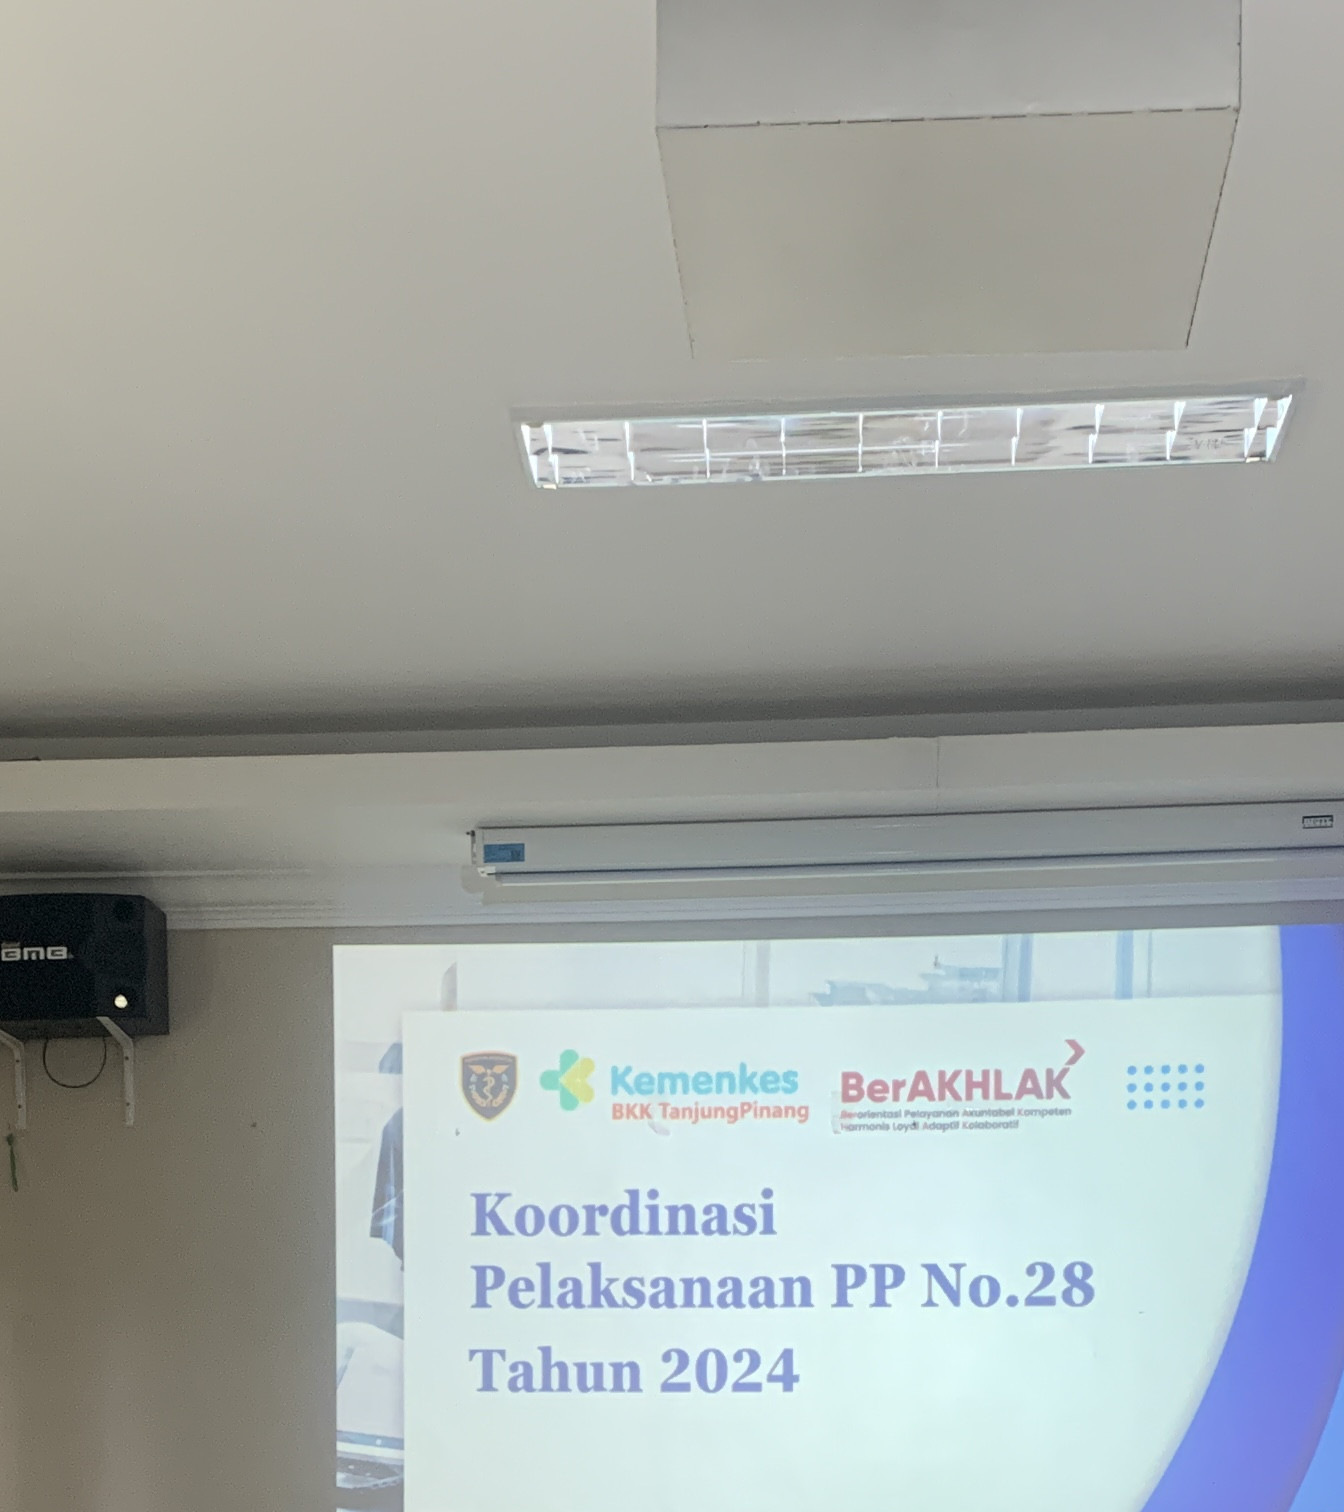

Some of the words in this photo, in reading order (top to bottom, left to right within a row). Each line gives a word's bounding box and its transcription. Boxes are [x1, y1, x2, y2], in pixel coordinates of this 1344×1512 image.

[610, 1062, 799, 1095] Kemenkes
[841, 1067, 1072, 1103] BerAKHLAK
[612, 1103, 652, 1120] BKK
[658, 1101, 809, 1124] TanjungPinang
[470, 1188, 777, 1237] Koordinasi
[470, 1261, 814, 1309] Pelaksanaan
[831, 1263, 906, 1308] PP
[920, 1261, 1095, 1308] No.28
[468, 1346, 643, 1393] Tahun
[660, 1348, 799, 1393] 2024
